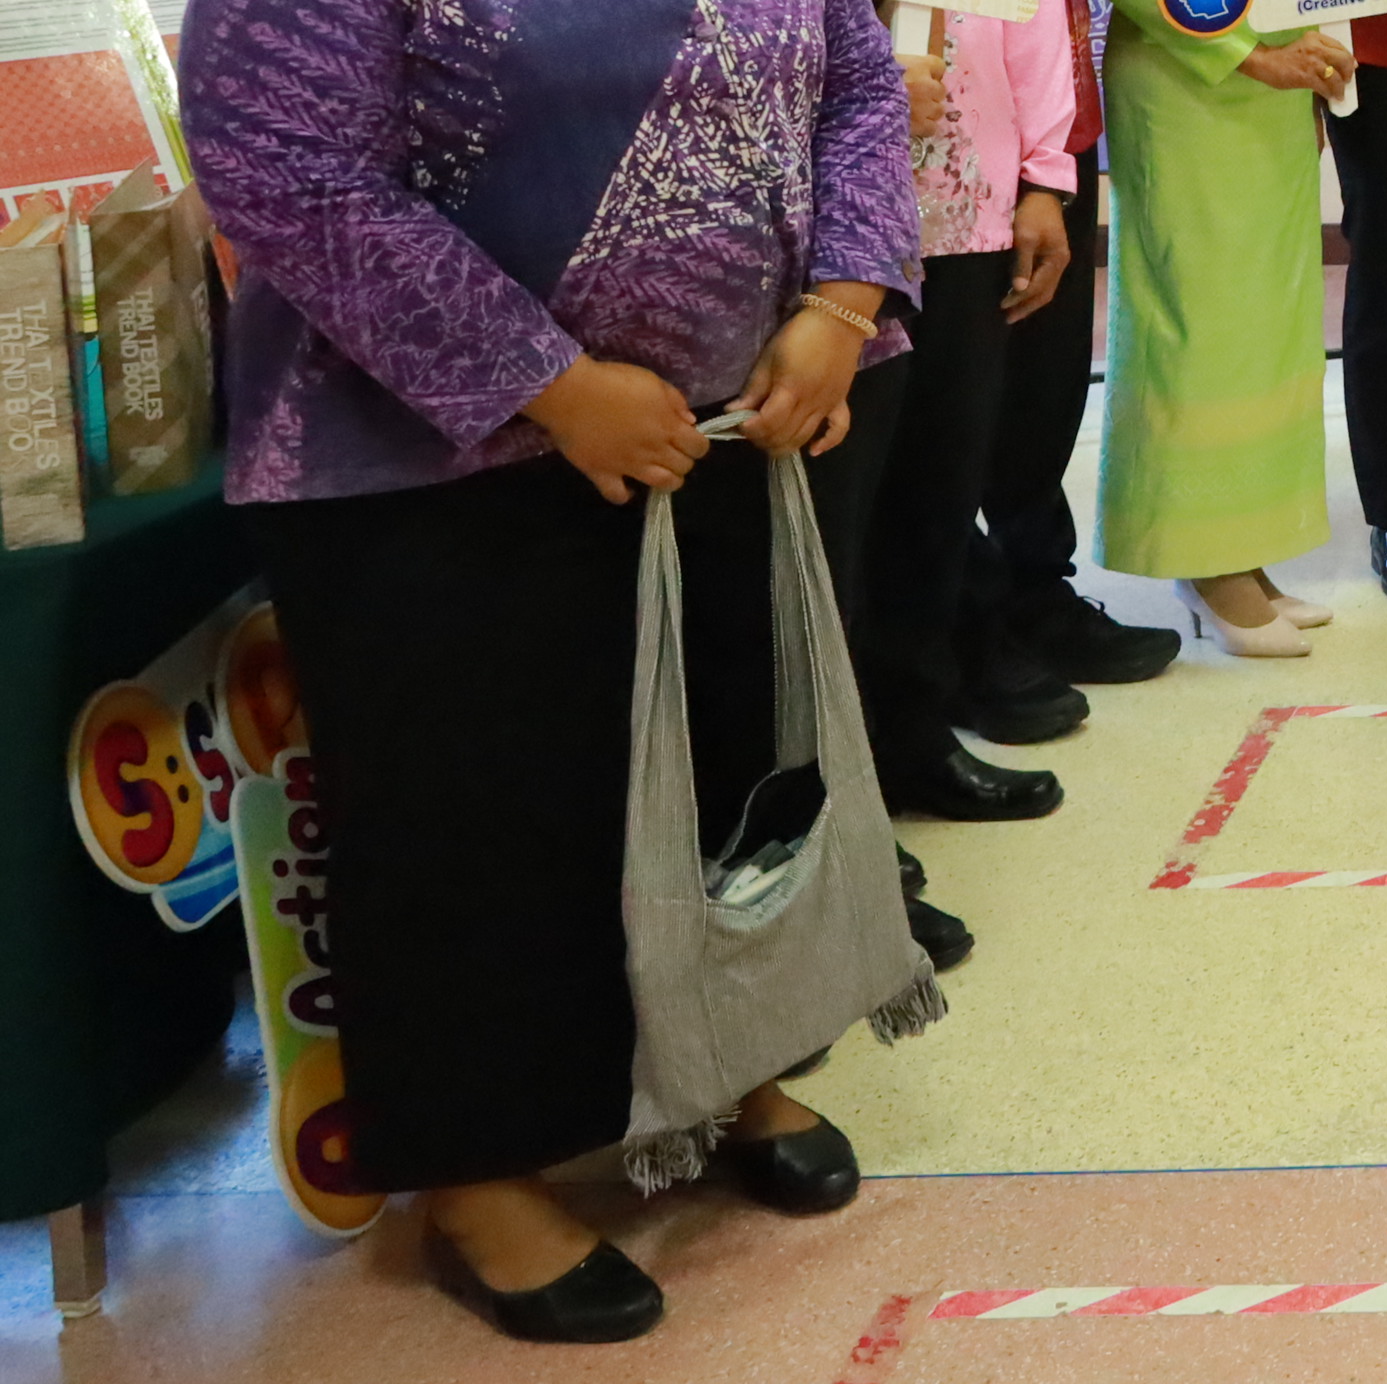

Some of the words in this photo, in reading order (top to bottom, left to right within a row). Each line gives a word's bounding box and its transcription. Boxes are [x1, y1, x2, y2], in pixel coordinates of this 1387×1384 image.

[117, 296, 138, 358] TREND
[135, 287, 155, 331] THAI
[122, 363, 144, 414] BOOK
[138, 335, 163, 420] TEXTILES
[29, 359, 60, 470] TXTILES
